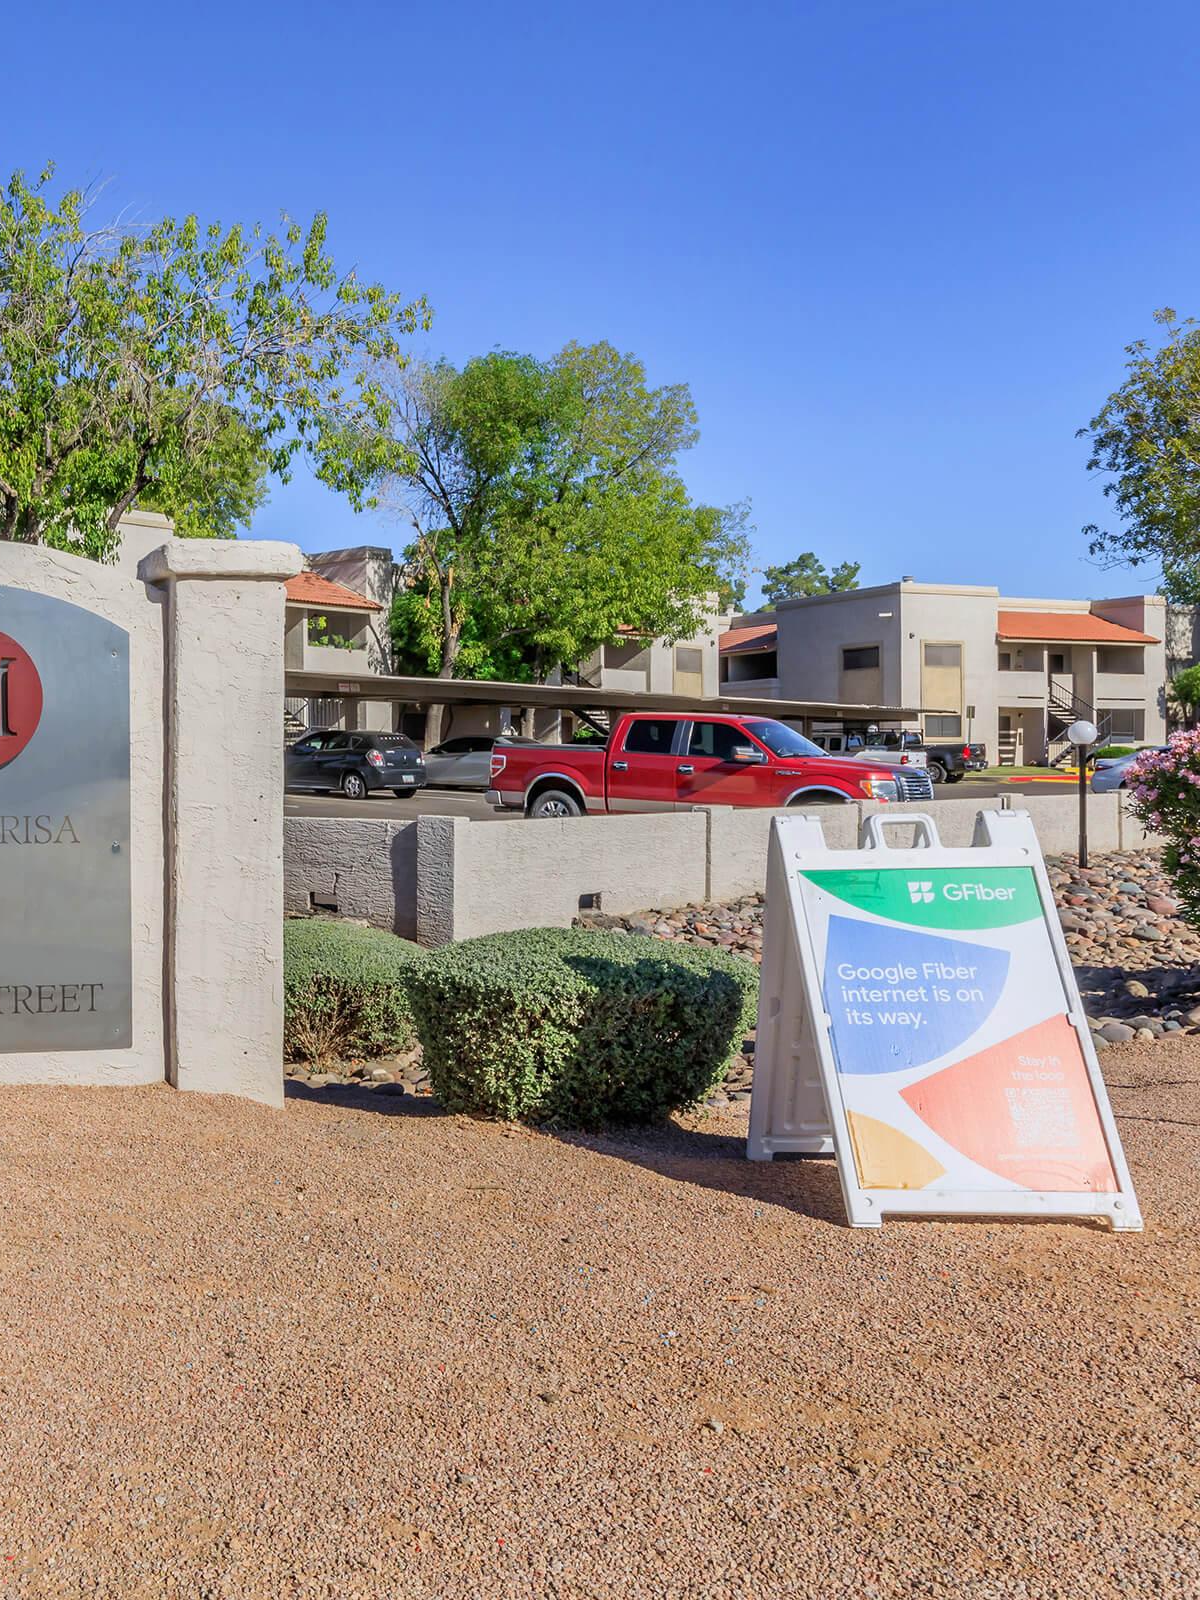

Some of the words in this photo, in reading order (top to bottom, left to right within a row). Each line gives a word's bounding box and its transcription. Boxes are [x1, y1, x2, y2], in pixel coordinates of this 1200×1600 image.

[942, 883, 1016, 901] GFiber
[837, 963, 918, 984] Google
[922, 962, 978, 980] Fiber
[841, 985, 929, 1002] internet
[932, 985, 951, 1002] is
[956, 988, 985, 1002] on
[846, 1008, 874, 1025] its
[878, 1011, 928, 1029] way.
